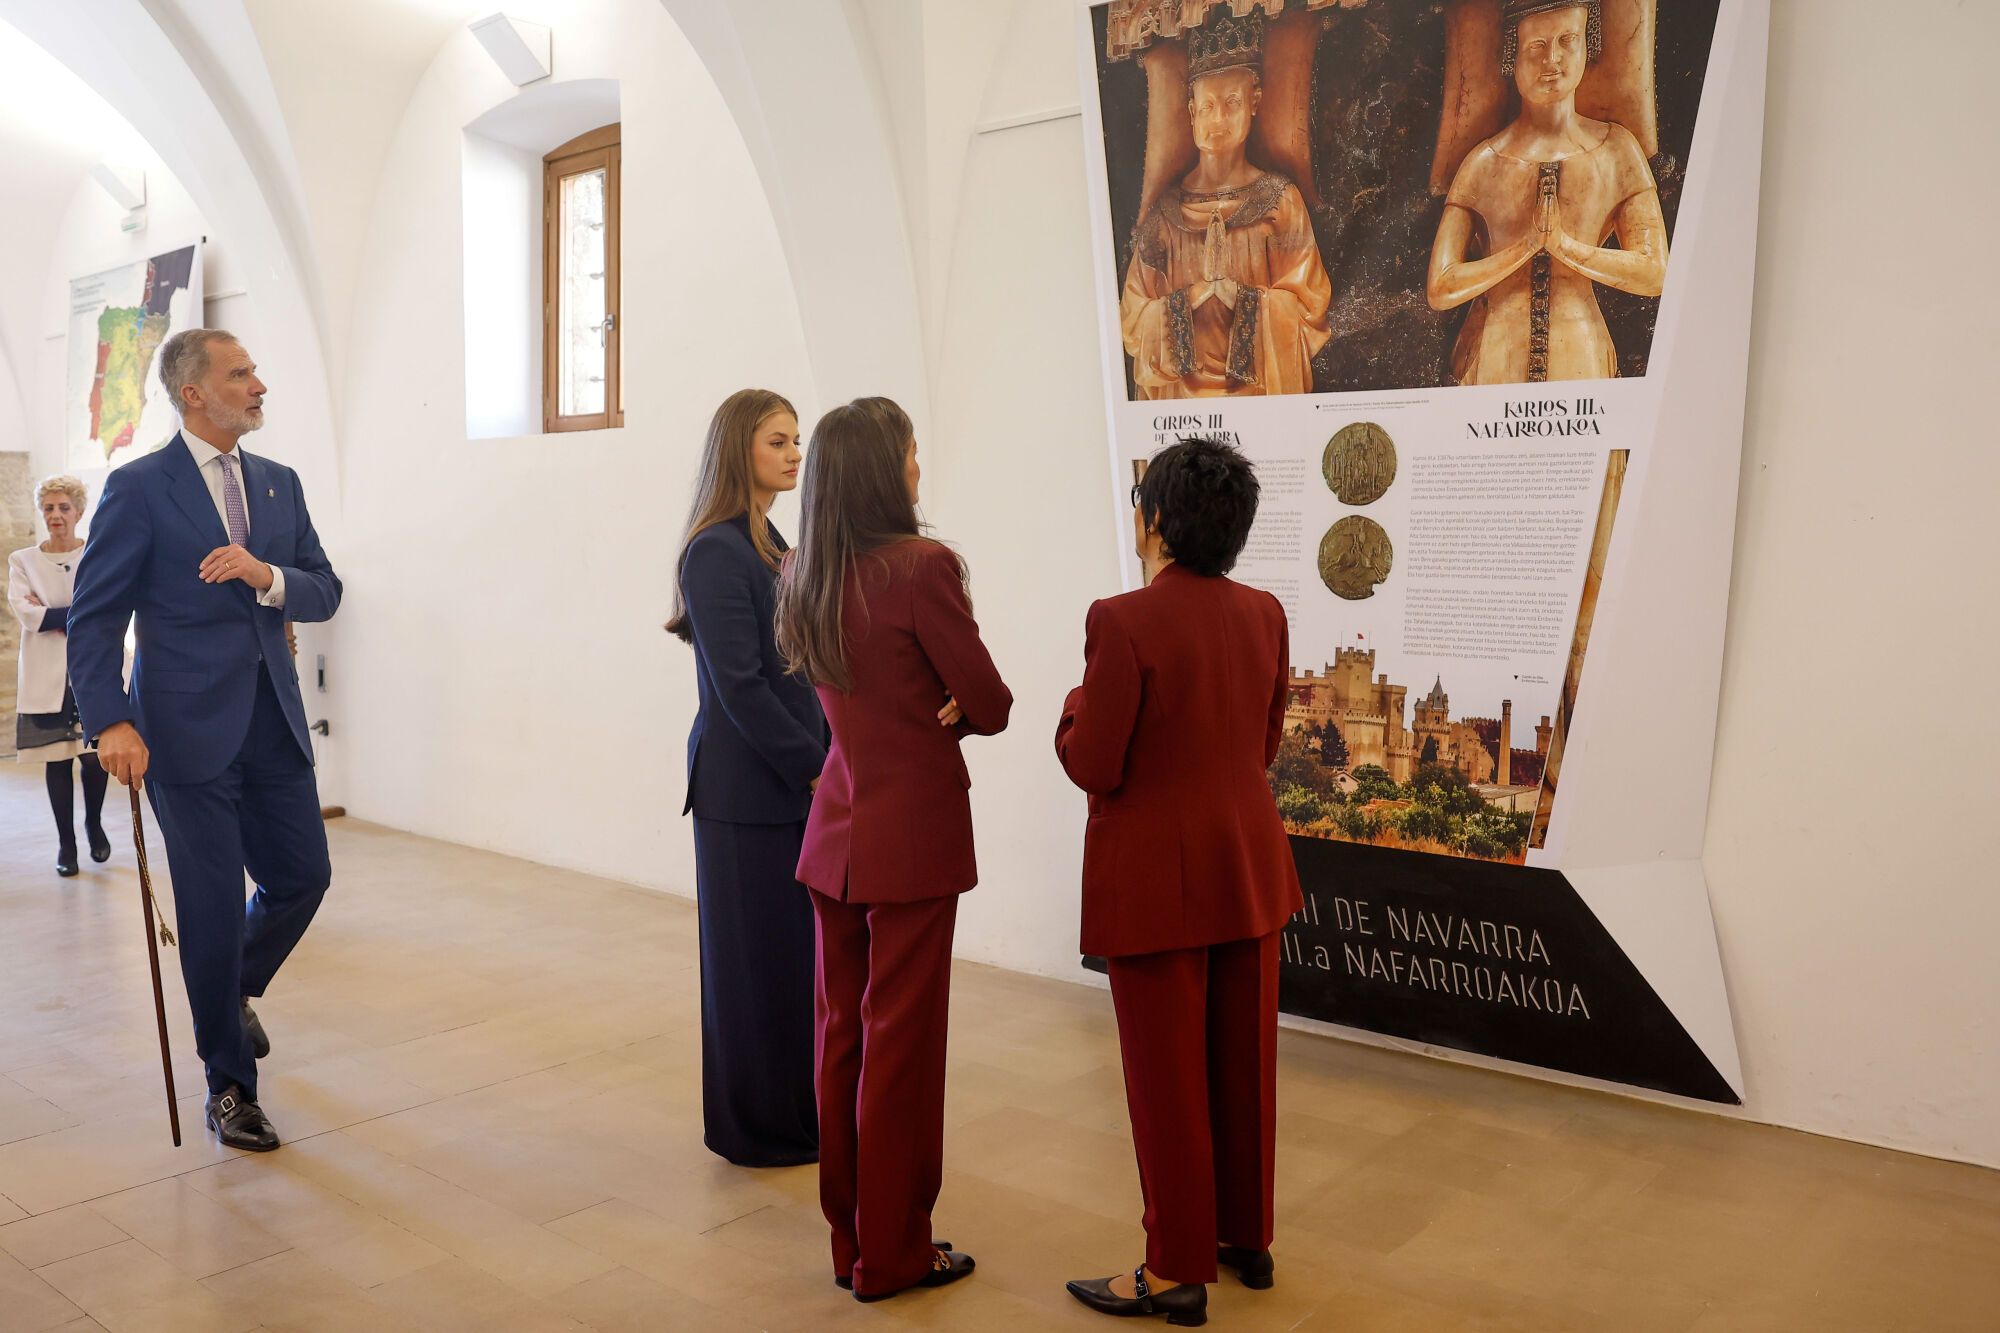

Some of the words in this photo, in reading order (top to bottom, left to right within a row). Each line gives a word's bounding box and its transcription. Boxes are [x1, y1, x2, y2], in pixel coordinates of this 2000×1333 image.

[1504, 400, 1568, 418] KARLOS
[1153, 415, 1202, 430] CARLOS
[1209, 414, 1222, 428] III
[1466, 419, 1600, 439] NAFARROAKOA
[1155, 433, 1168, 444] DE
[1293, 893, 1319, 925] II
[1335, 897, 1373, 934] DE
[1387, 905, 1550, 965] NAVARRA
[1279, 932, 1331, 970] II.a
[1344, 942, 1590, 1019] NAFARROAKOA
